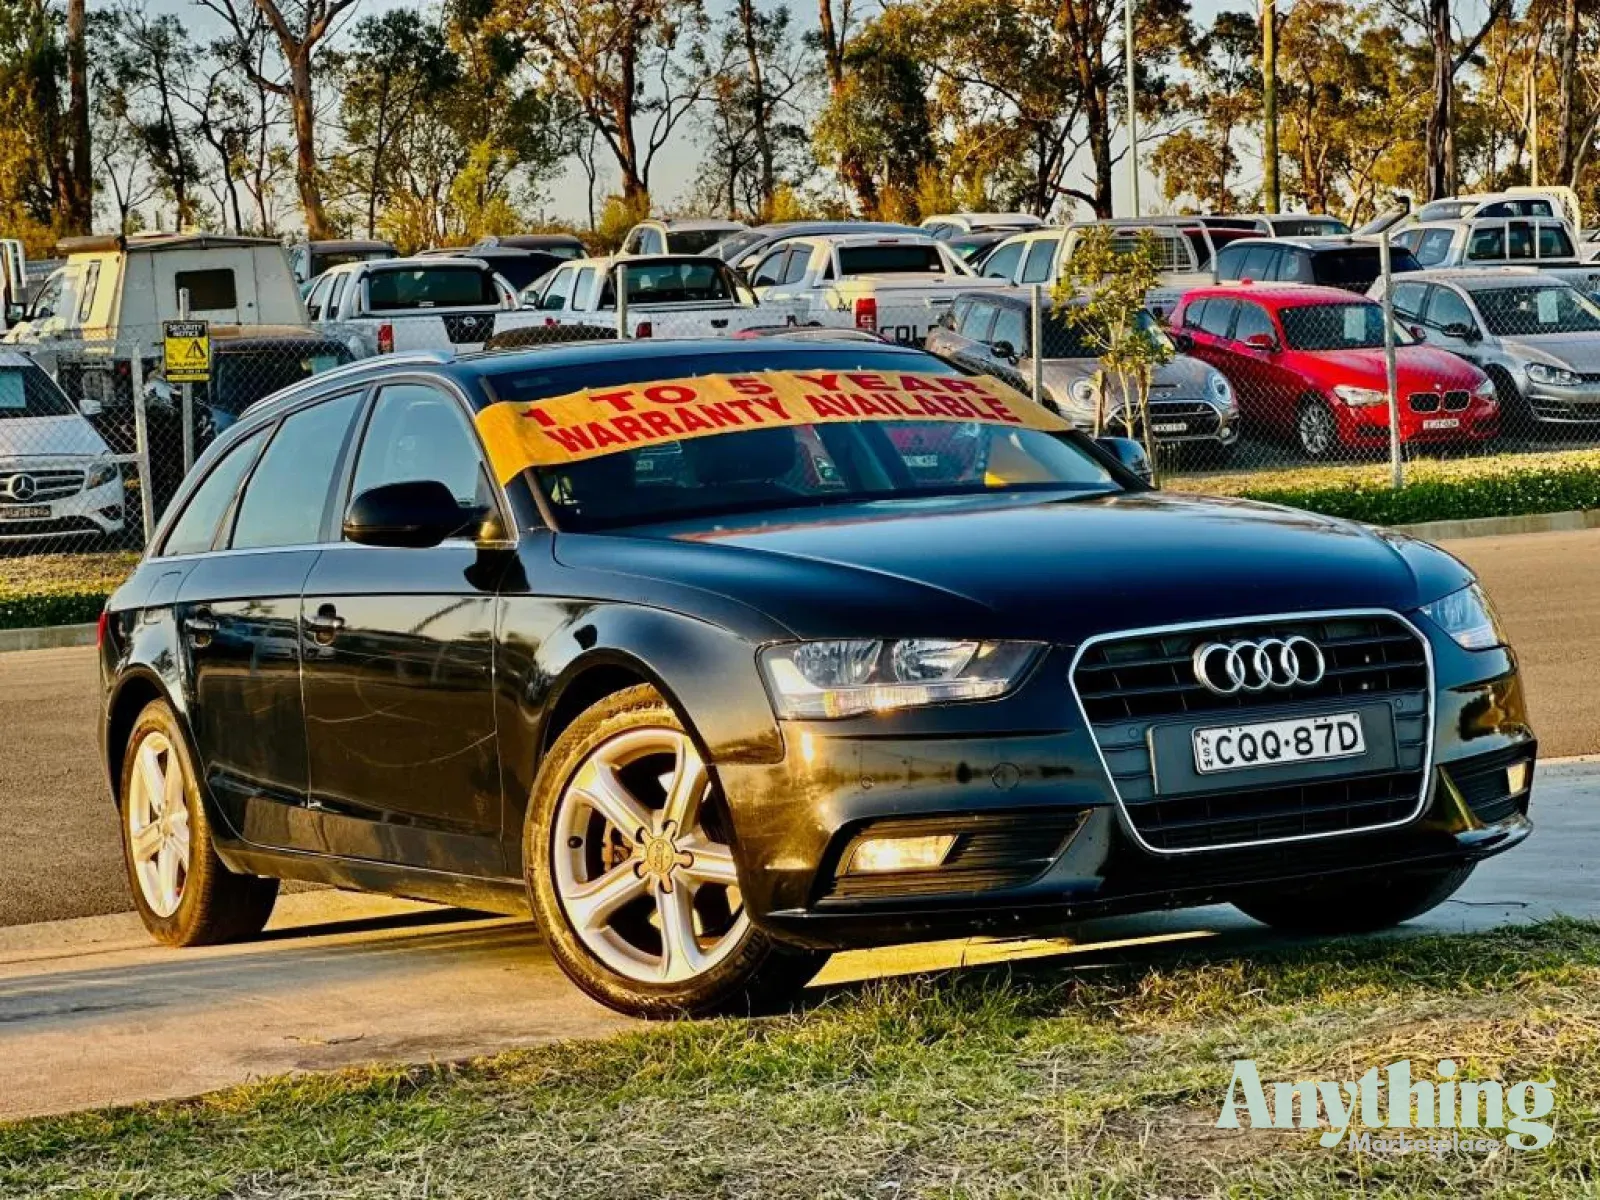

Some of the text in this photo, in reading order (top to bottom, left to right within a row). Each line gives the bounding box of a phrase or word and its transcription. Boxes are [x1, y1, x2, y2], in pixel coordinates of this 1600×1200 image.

[521, 374, 989, 427] 1 TO 5 YEAR
[543, 393, 1023, 452] WARRANTY AVAILABLE
[1201, 736, 1213, 768] NSW
